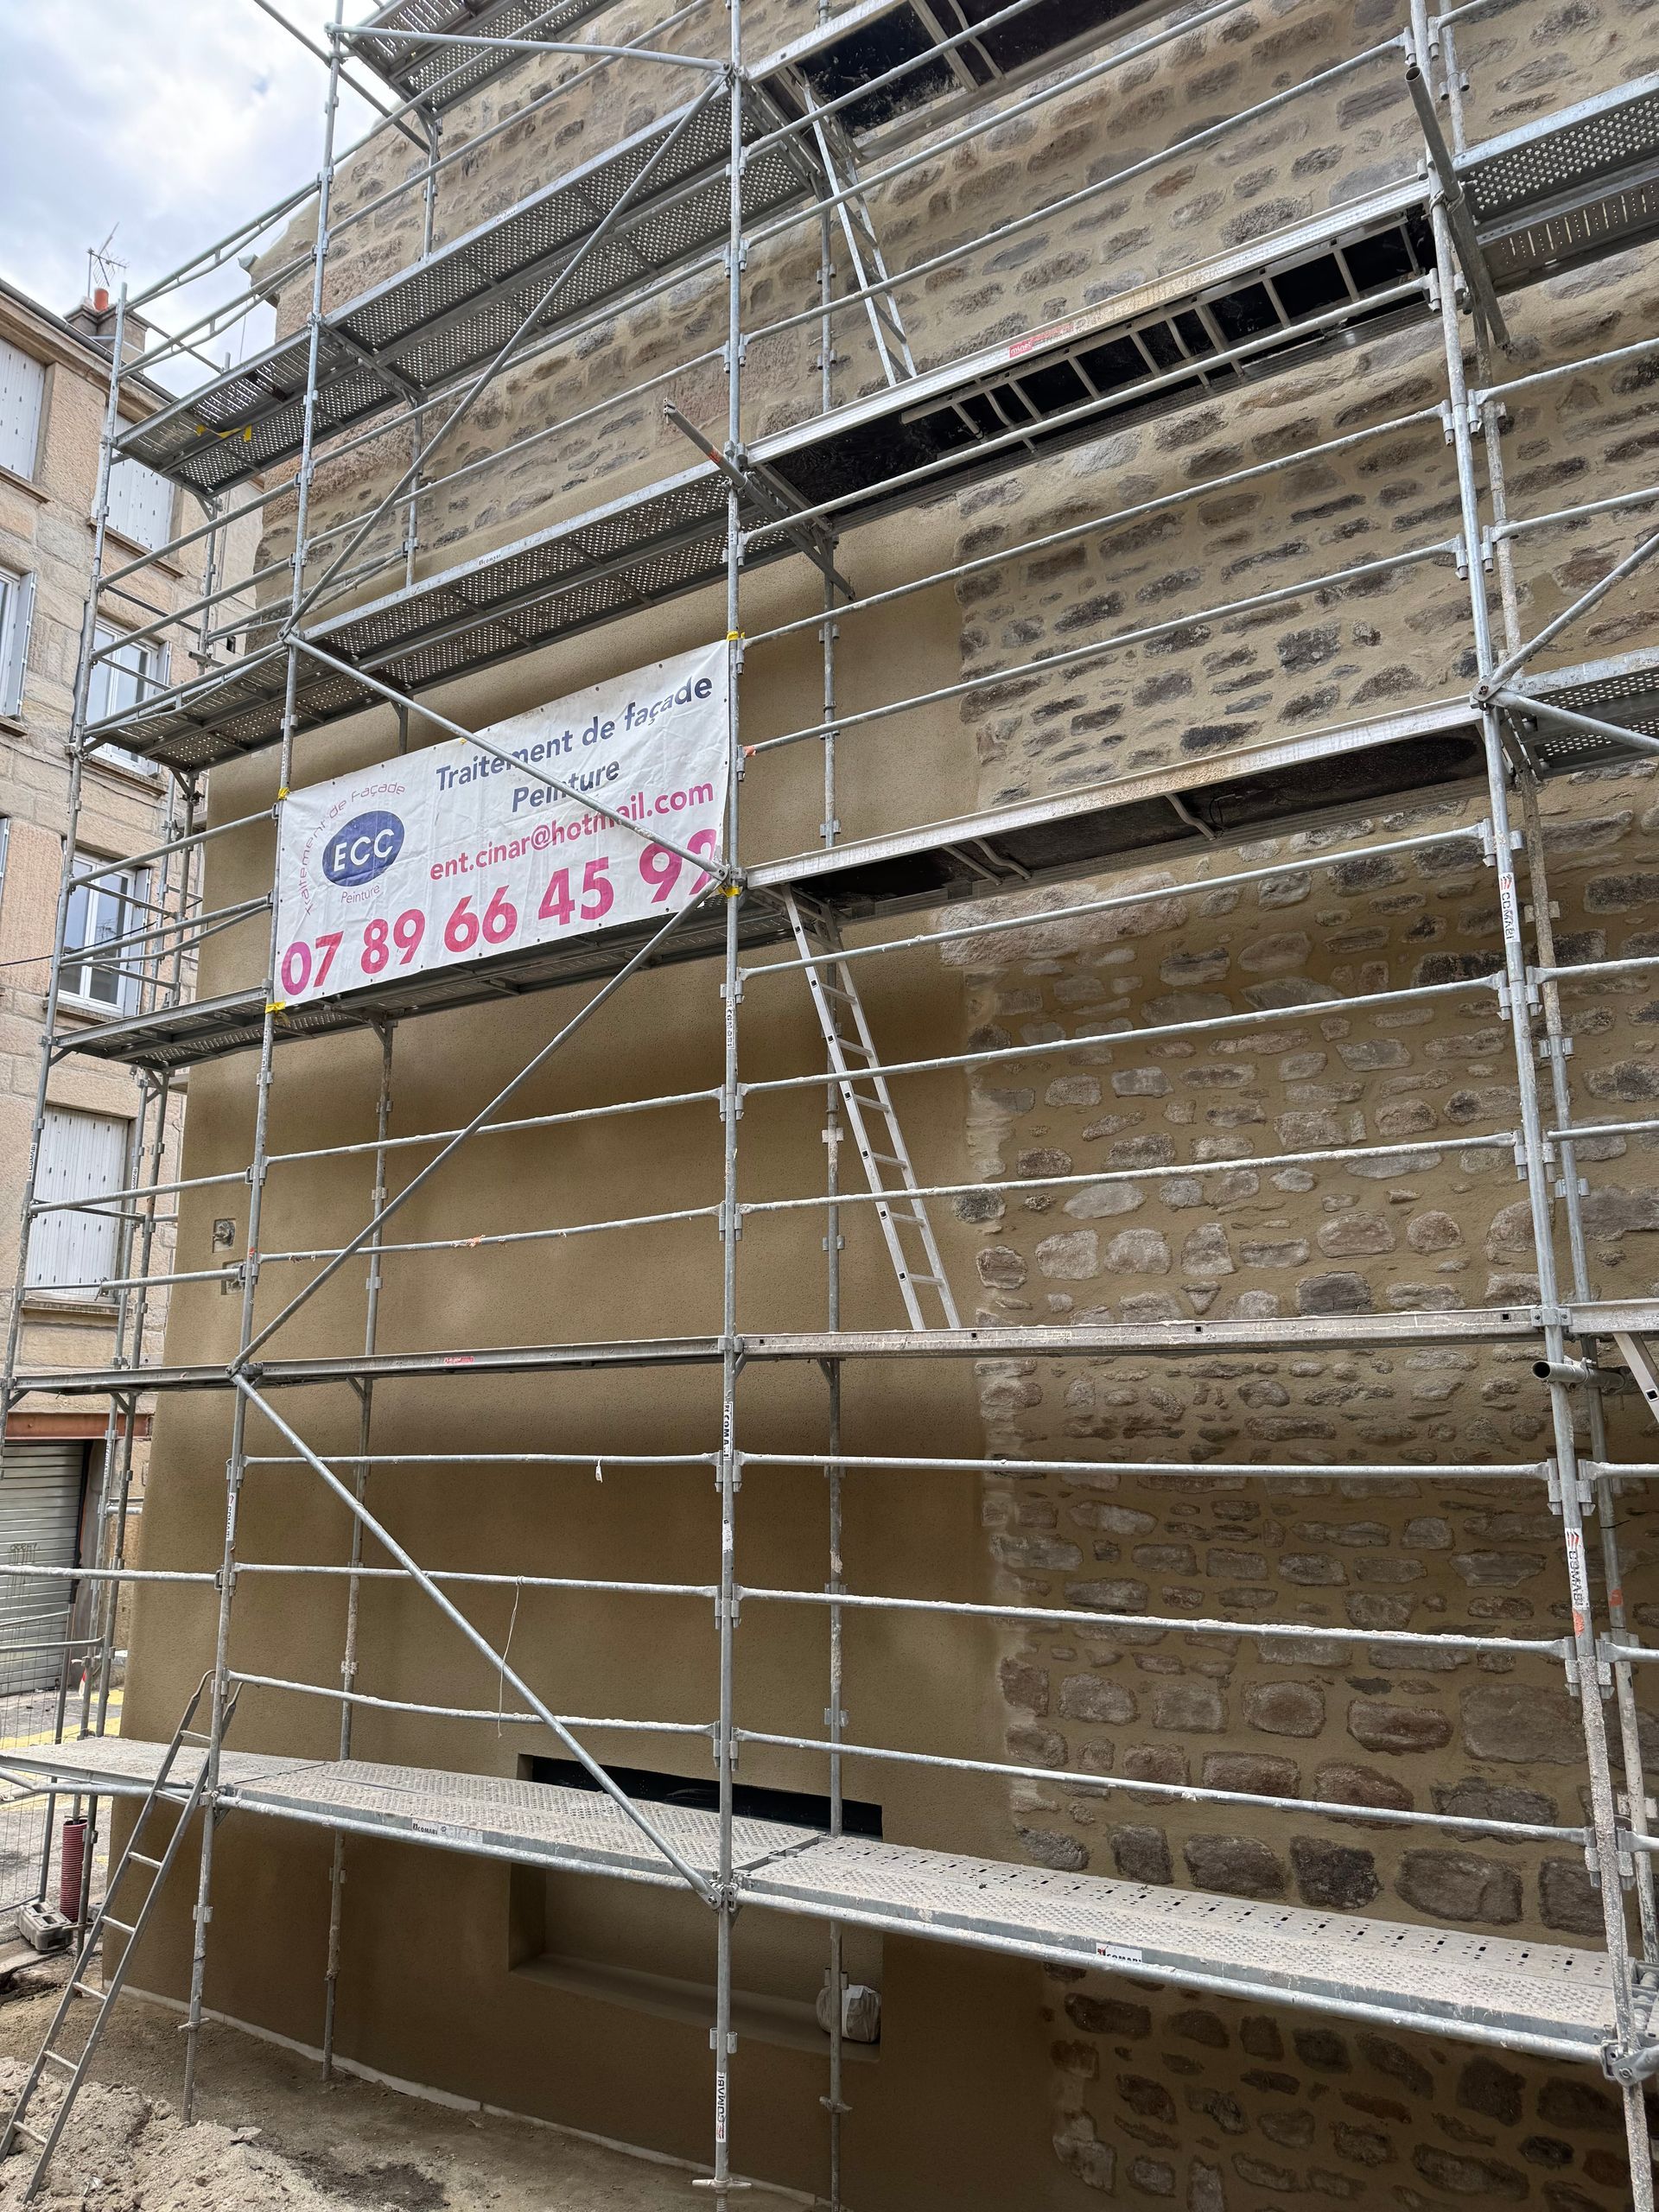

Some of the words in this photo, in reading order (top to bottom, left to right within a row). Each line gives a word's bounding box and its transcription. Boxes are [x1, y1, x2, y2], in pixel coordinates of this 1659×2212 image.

[435, 729, 573, 791] Traitement
[582, 716, 615, 747] de
[624, 677, 713, 732] façade
[328, 800, 347, 820] de
[512, 760, 620, 813] Peinture
[334, 829, 395, 872] ECC
[429, 783, 714, 881] ent.cinar@hotmail.com
[340, 884, 381, 904] Peinture
[1502, 892, 1515, 939] COMABI
[282, 931, 343, 995] 07
[361, 908, 425, 975] 89
[444, 885, 518, 952] 66
[537, 856, 614, 925] 45
